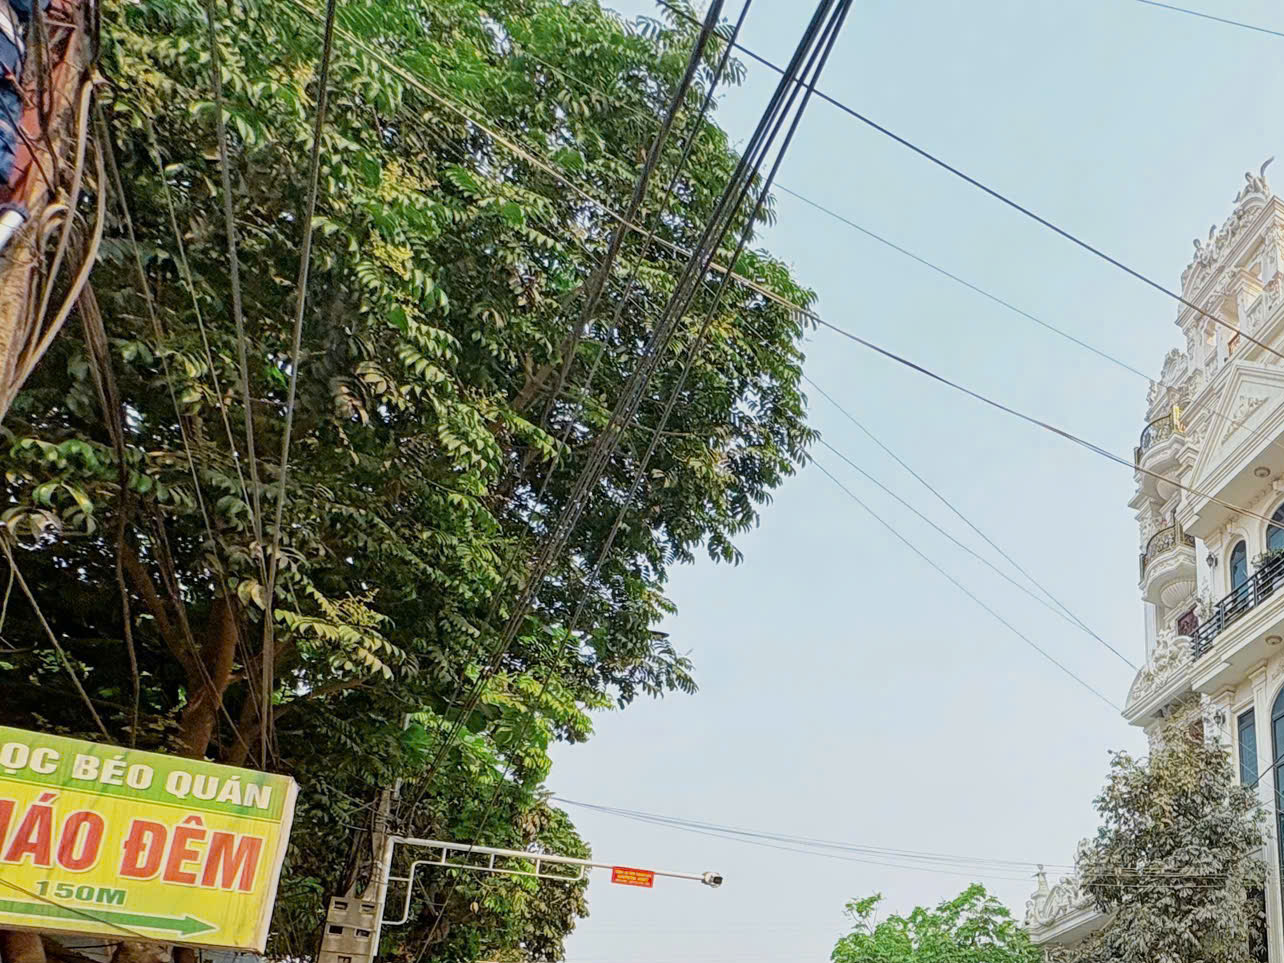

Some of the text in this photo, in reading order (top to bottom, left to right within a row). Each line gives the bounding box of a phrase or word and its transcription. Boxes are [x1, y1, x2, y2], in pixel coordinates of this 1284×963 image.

[72, 754, 154, 790] BÉO
[166, 771, 272, 810] QUÁN
[119, 815, 264, 893] ĐÊM
[36, 880, 127, 905] 150M
